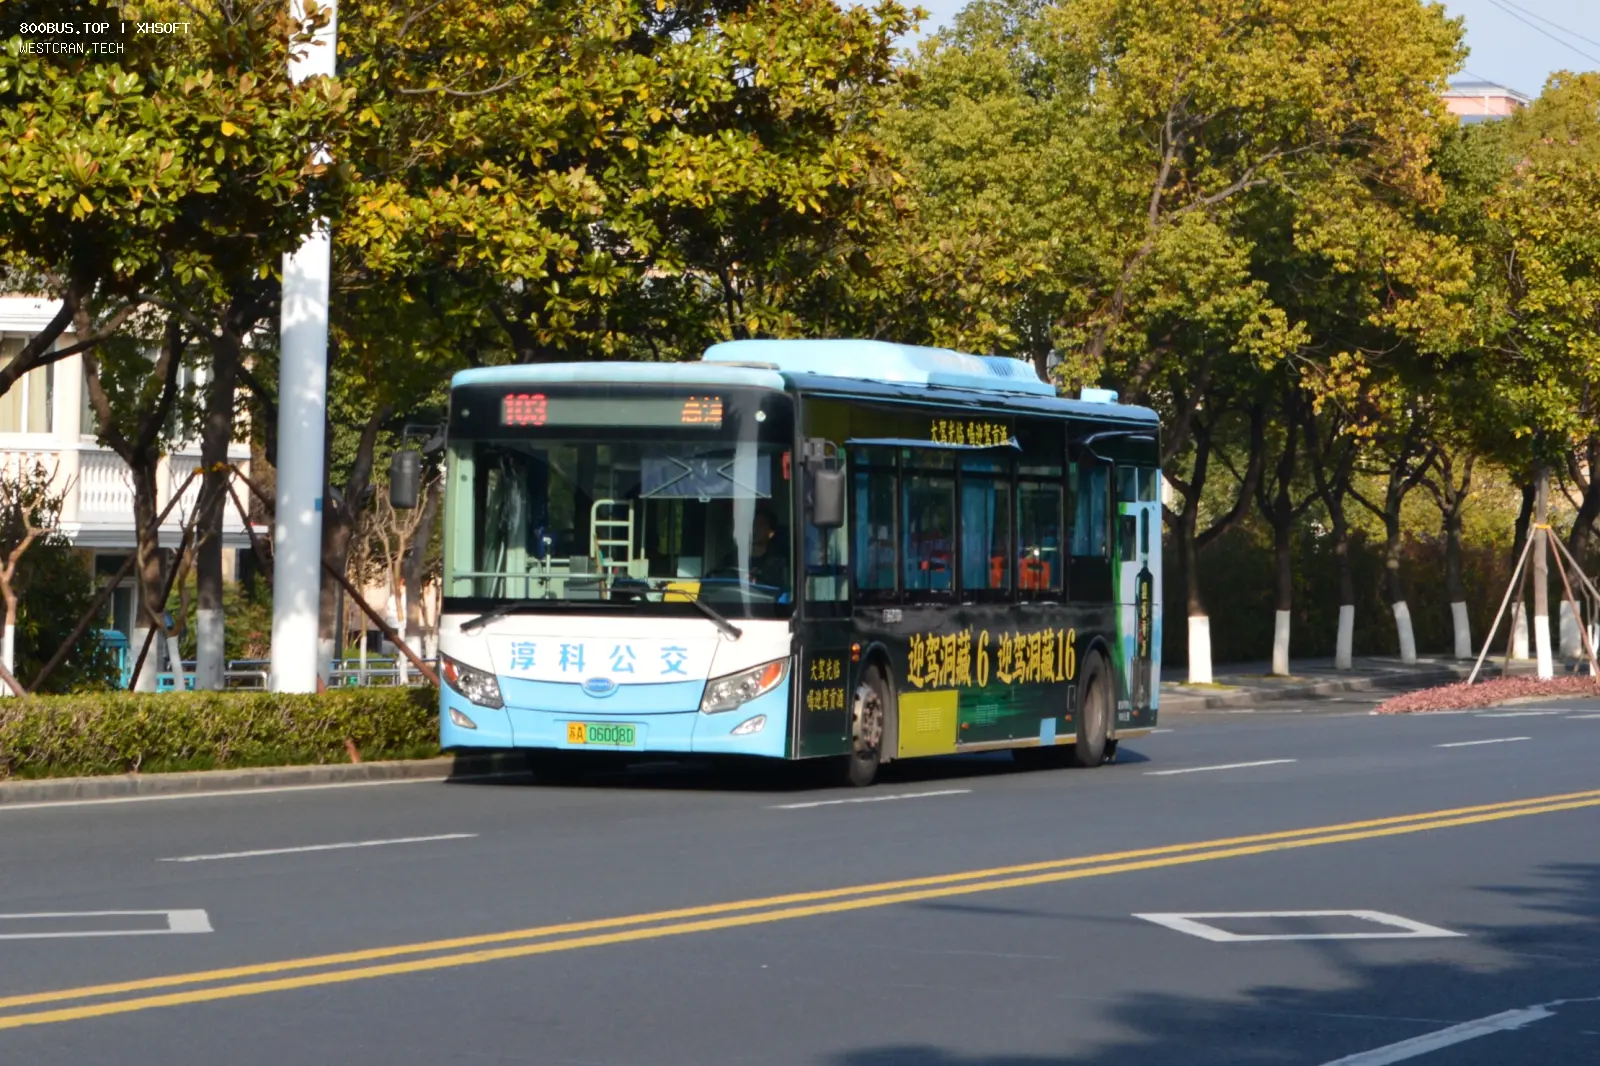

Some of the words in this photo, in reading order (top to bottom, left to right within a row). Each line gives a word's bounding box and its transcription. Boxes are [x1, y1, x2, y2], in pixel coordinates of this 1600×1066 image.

[504, 392, 547, 426] 103
[510, 641, 688, 675] 淳科公交
